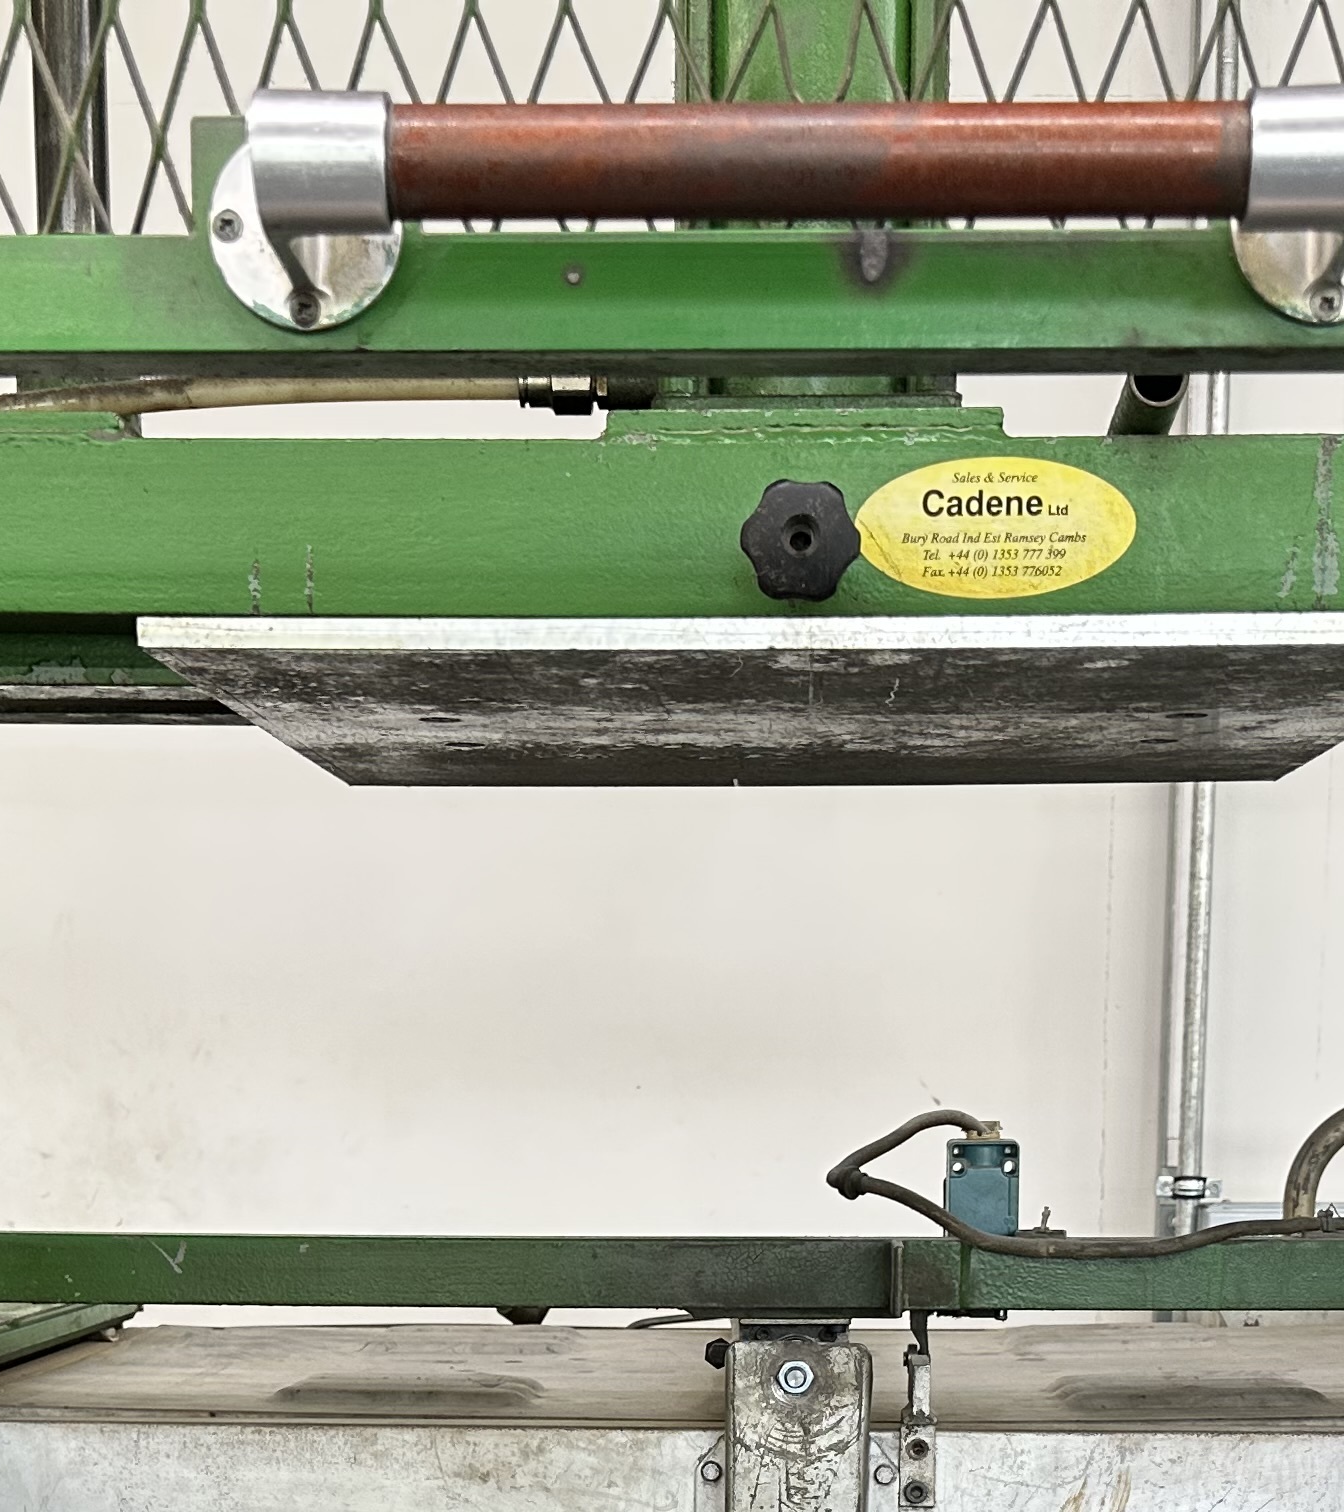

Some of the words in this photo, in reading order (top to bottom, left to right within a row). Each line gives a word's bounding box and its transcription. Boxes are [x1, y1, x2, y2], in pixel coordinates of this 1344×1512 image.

[952, 471, 981, 484] Sales
[983, 472, 995, 484] &
[998, 471, 1039, 484] Service
[922, 489, 1044, 517] Cadene
[1047, 504, 1069, 516] Ltd
[902, 532, 928, 547] Bury
[931, 532, 959, 544] Road
[962, 532, 981, 544] Ind
[983, 532, 1001, 544] Est
[1004, 532, 1046, 546] Ramsey
[1048, 531, 1087, 544] Cambs
[923, 549, 941, 561] Tel.
[948, 549, 970, 561] +44
[973, 549, 989, 562] (0)
[992, 549, 1019, 560] 1353
[1022, 549, 1043, 560] 777
[1044, 549, 1067, 560] 399
[948, 566, 970, 578] +44
[972, 566, 989, 579] (0)
[991, 566, 1019, 577] 1353
[1022, 566, 1063, 577] 776052
